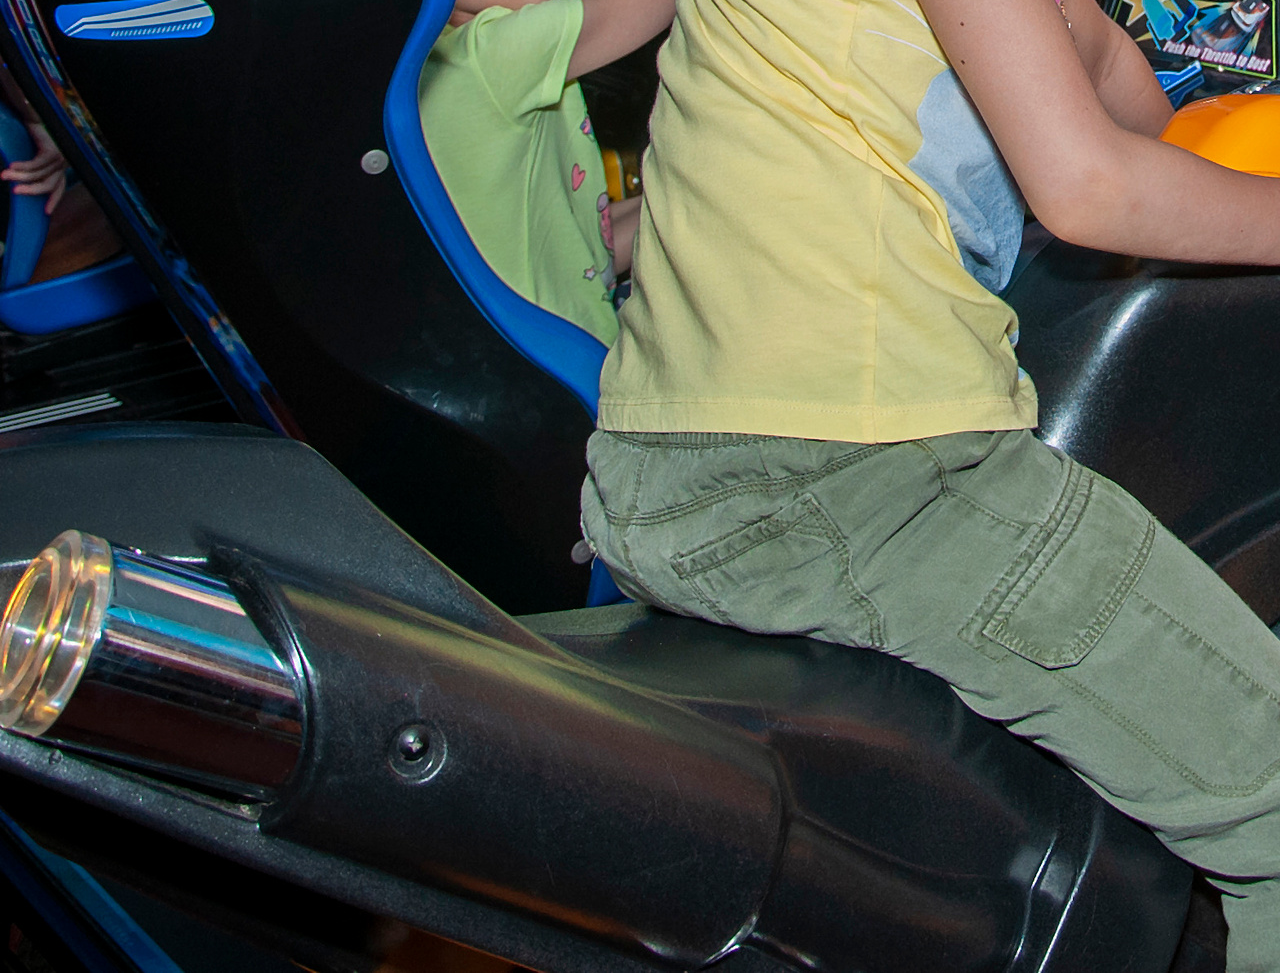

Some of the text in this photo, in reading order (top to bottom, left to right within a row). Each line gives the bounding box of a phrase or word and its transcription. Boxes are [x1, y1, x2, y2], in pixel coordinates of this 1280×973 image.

[1162, 41, 1186, 55] Push
[1185, 44, 1201, 58] the
[1201, 47, 1237, 65] Throttle
[1236, 55, 1248, 68] to
